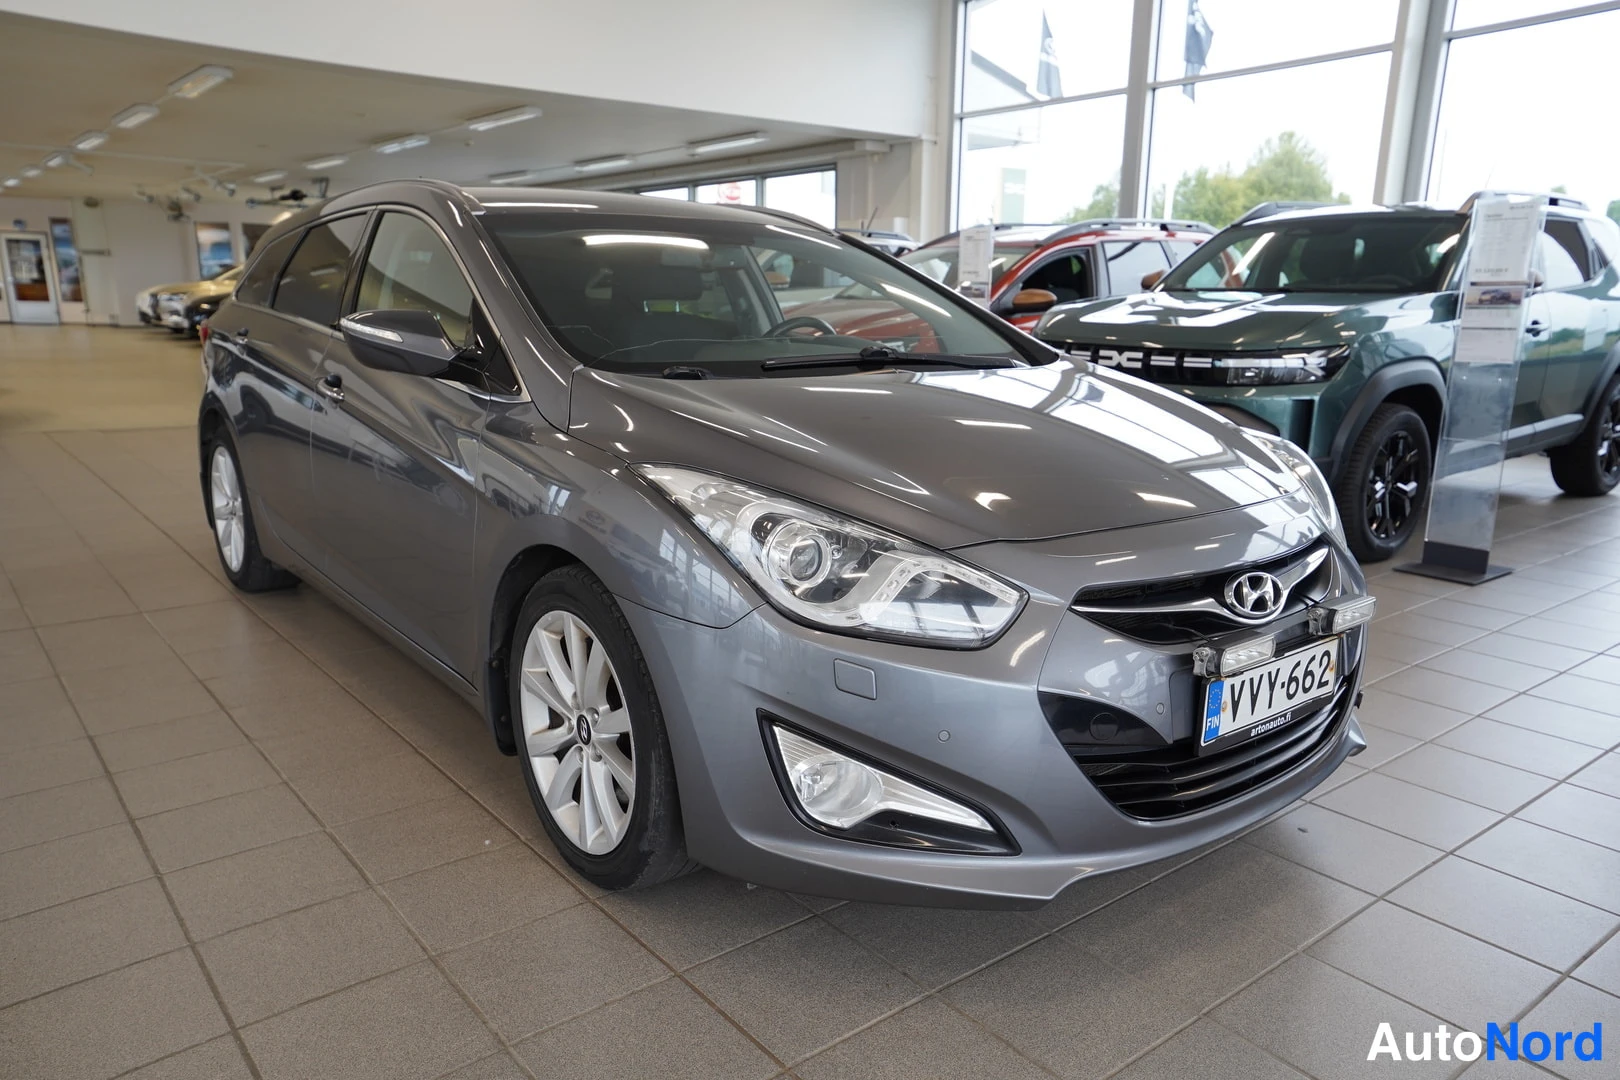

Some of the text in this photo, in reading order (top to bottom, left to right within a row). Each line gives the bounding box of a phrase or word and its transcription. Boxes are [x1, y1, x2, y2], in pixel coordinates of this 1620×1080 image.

[1230, 649, 1332, 723] VVY-662
[1206, 714, 1220, 731] FIN
[1250, 712, 1292, 737] artonauto.fi
